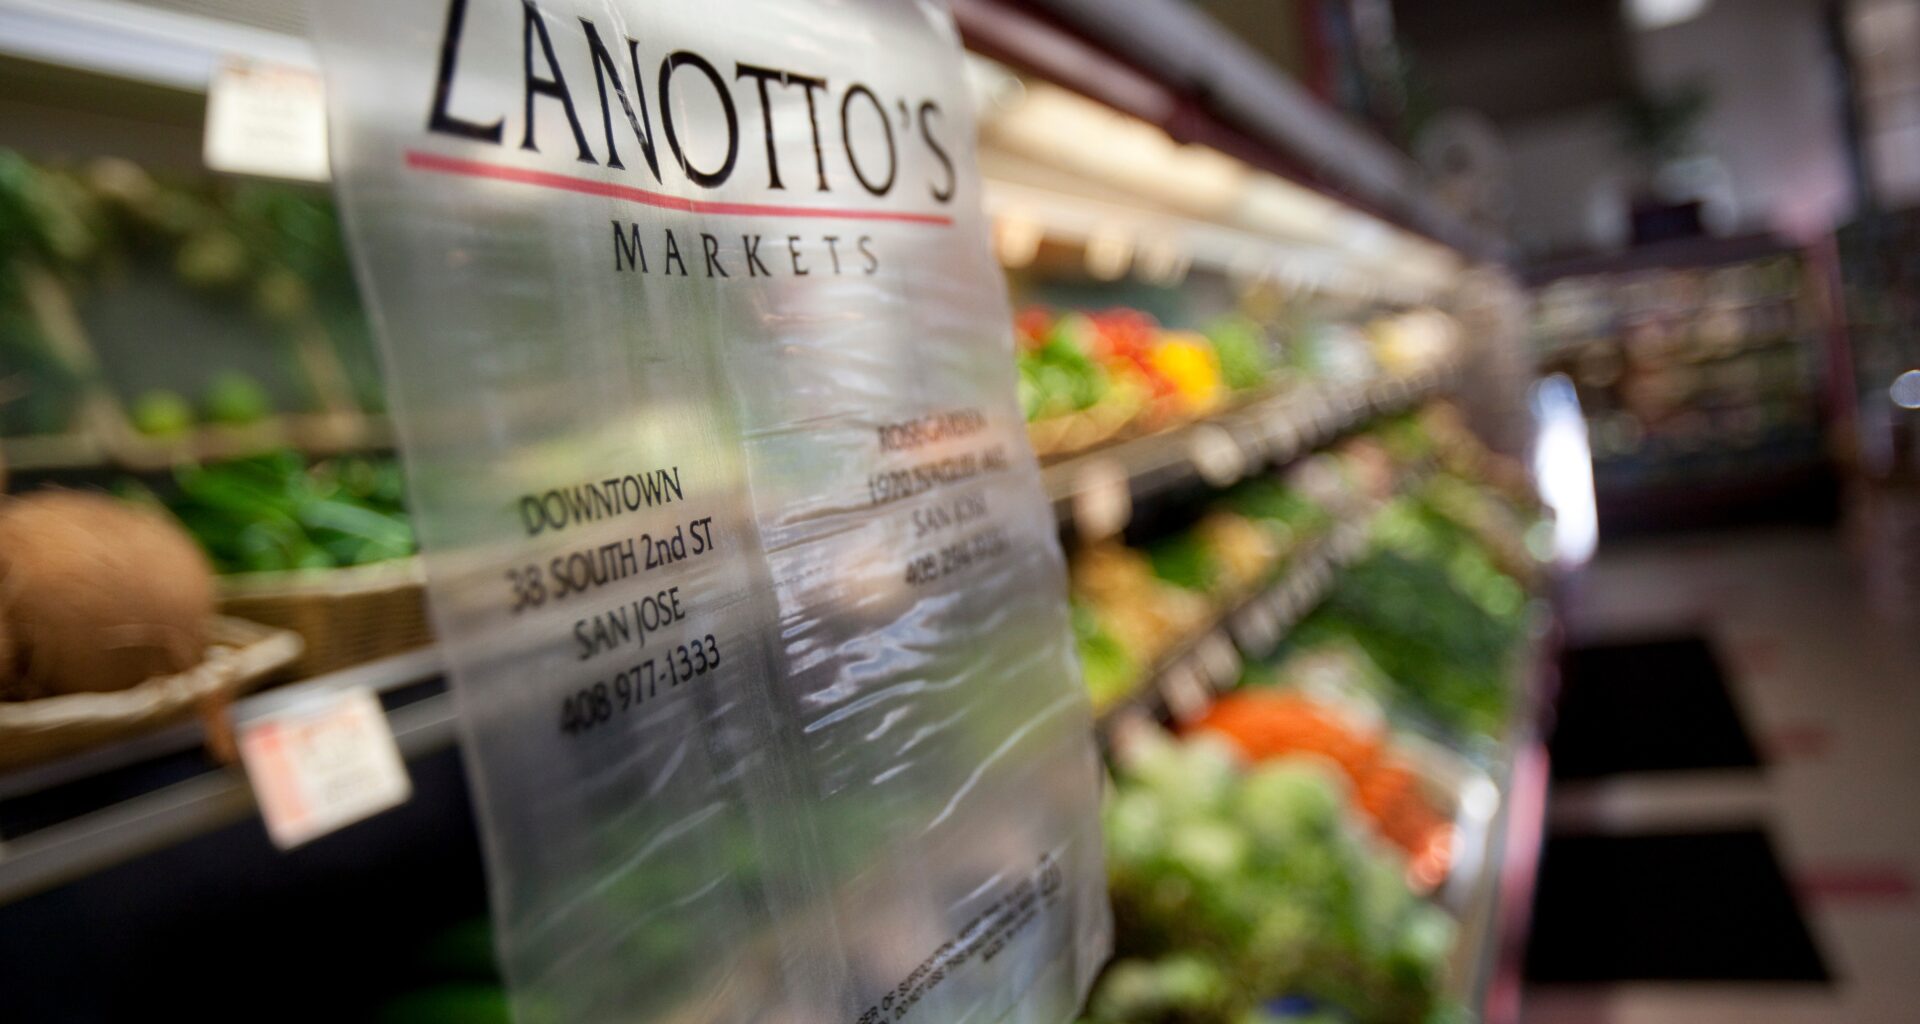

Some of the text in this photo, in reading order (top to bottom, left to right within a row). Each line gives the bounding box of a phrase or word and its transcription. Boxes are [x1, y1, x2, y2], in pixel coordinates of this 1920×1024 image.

[611, 220, 879, 278] MARKETS
[520, 466, 684, 536] DOWNTOWN
[505, 516, 715, 614] 38 SOUTH 2nd ST
[574, 586, 687, 661] SAN JOSE
[560, 633, 722, 735] 408 977-1333
